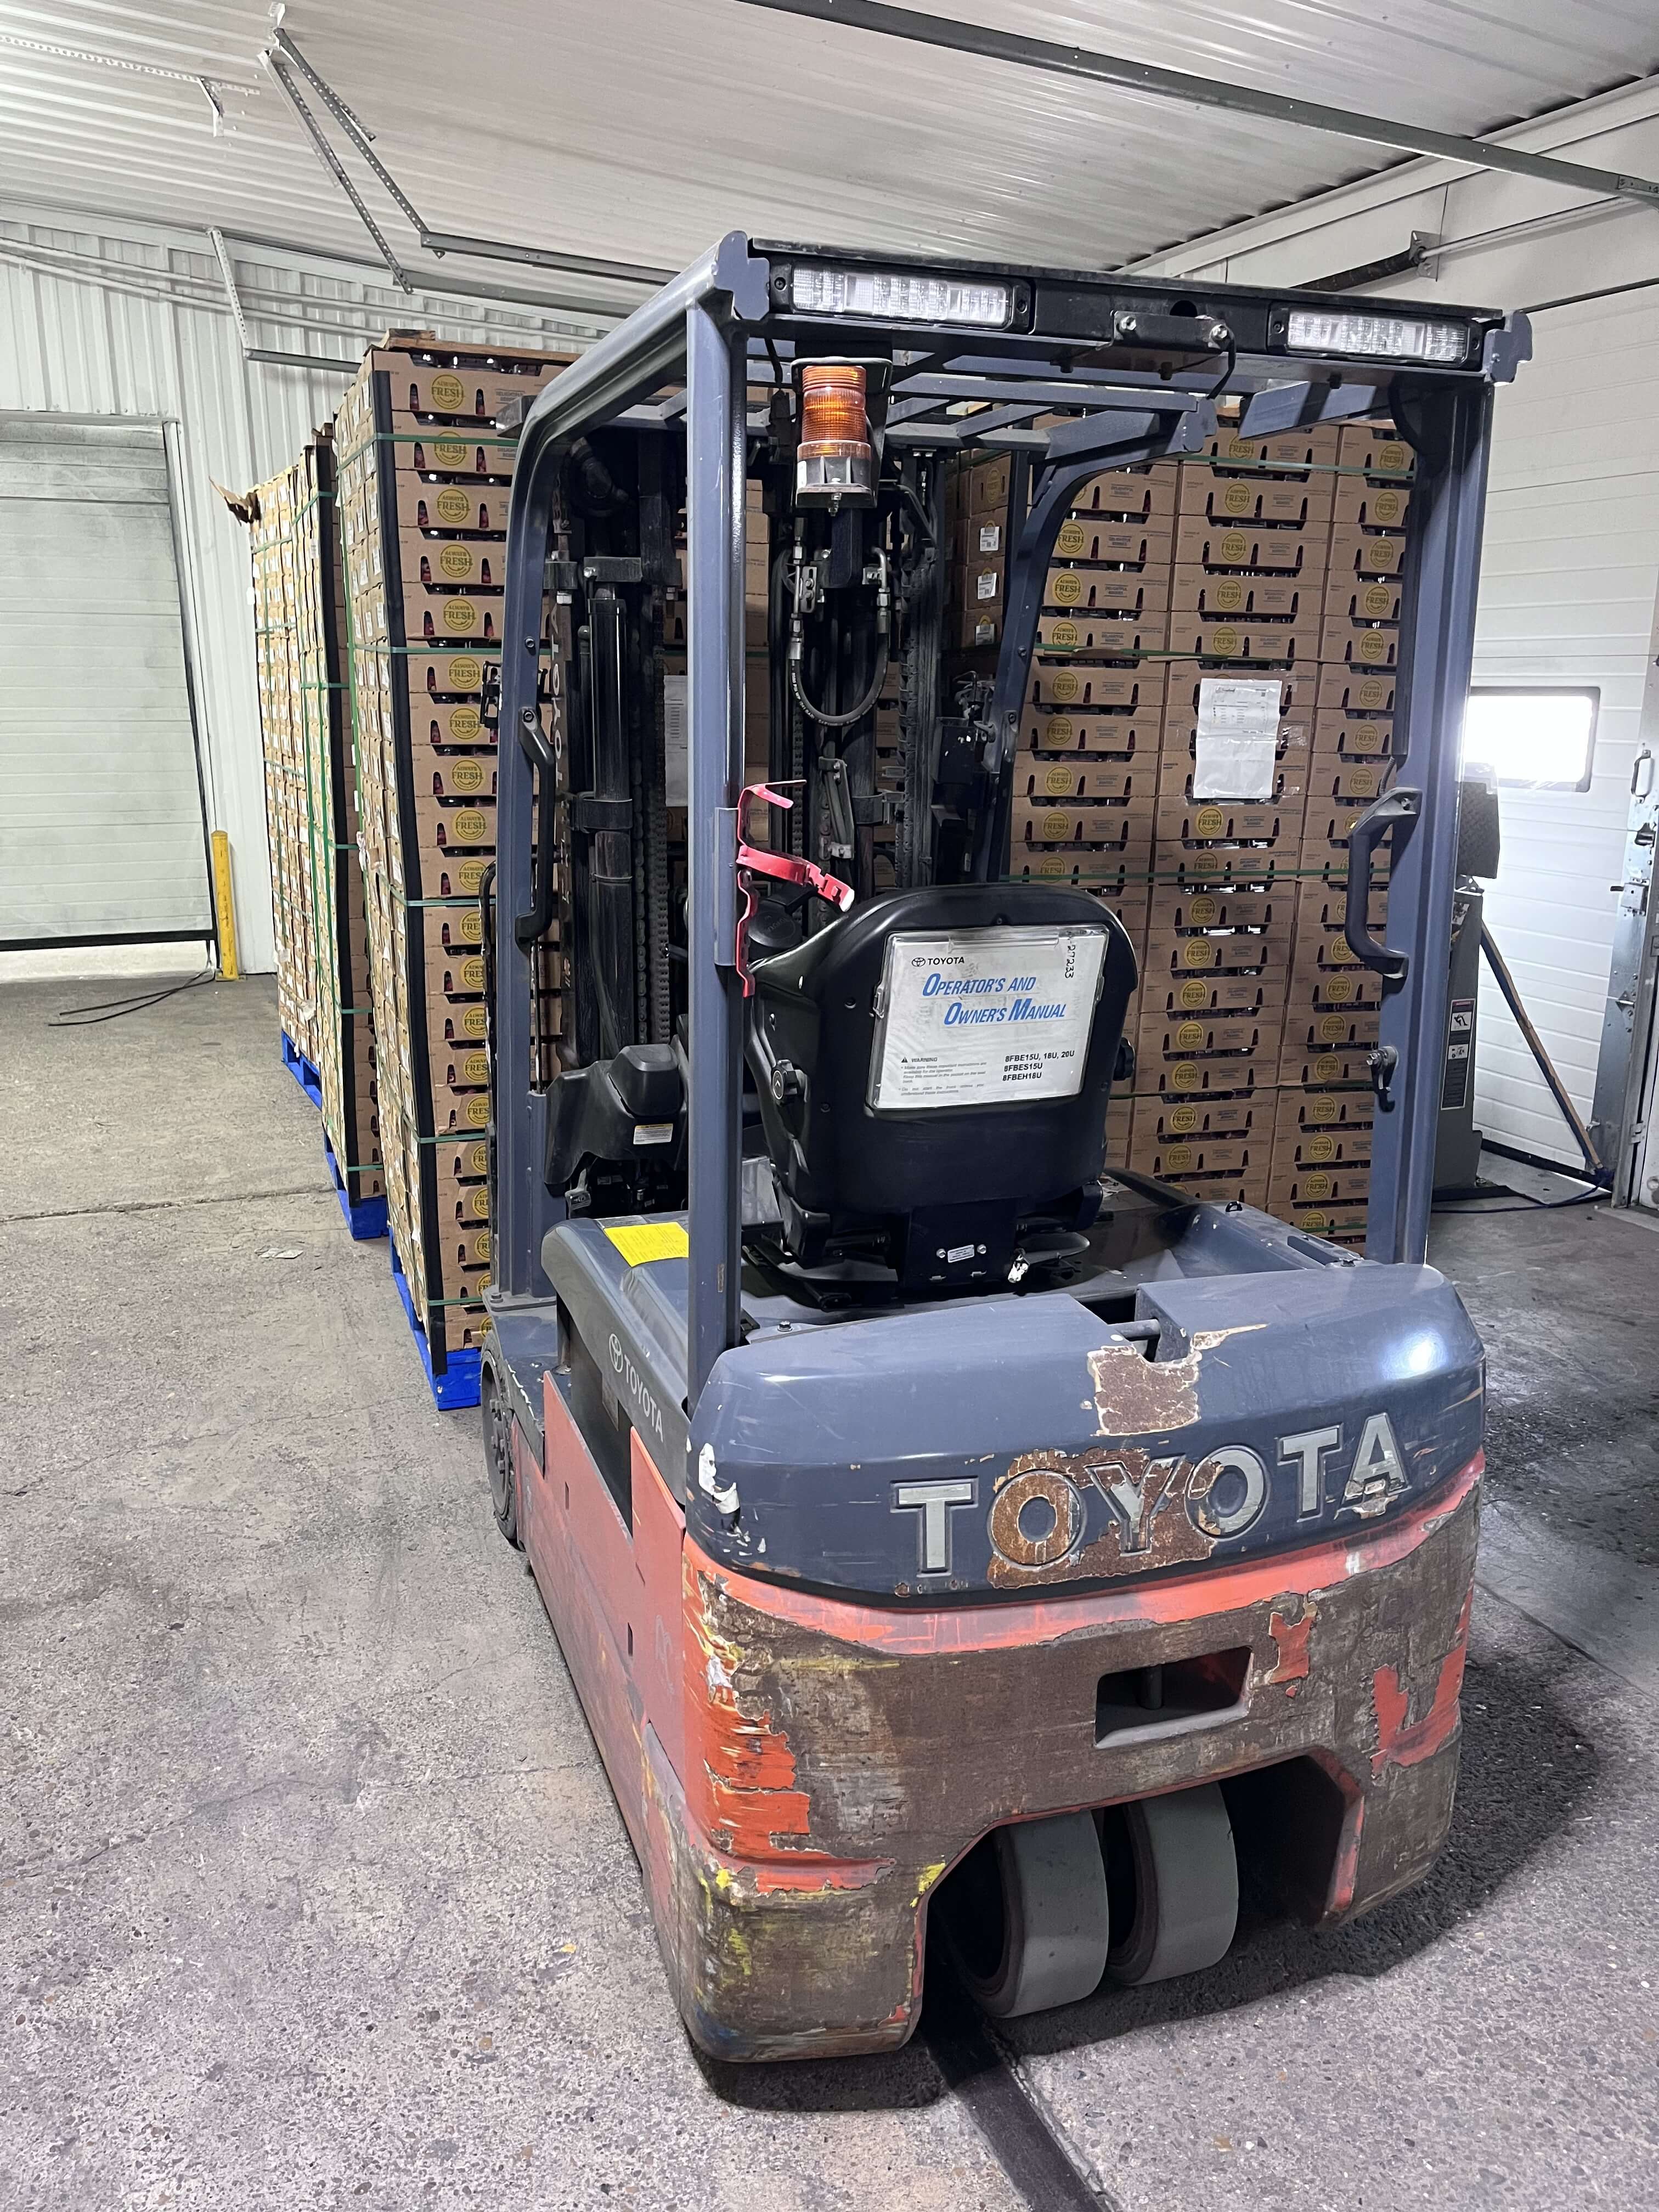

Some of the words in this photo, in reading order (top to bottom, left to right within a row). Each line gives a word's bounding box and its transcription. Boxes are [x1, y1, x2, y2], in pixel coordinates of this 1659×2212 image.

[431, 386, 465, 398] FRESH
[435, 443, 466, 454] FRESH
[437, 500, 470, 511] FRESH
[441, 556, 472, 567] FRESH
[444, 611, 476, 620] FRESH
[449, 669, 481, 678] FRESH
[449, 719, 481, 729] FRESH
[452, 771, 483, 780] FRESH
[455, 821, 487, 831] FRESH
[459, 871, 481, 879] FRES
[462, 923, 481, 931] FRE
[927, 956, 964, 966] TOYOTA
[922, 973, 1006, 996] OPERATOR'S
[1007, 977, 1036, 992] AND
[944, 1002, 1007, 1025] OWNER'S
[1008, 998, 1066, 1021] MANUAL
[465, 1018, 486, 1026] FRES
[1060, 1050, 1075, 1058] 20U
[465, 1063, 488, 1073] FRES
[1003, 1062, 1043, 1072] 8FBES15U
[1002, 1071, 1042, 1081] 8FBEH18U
[467, 1107, 490, 1116] FRES
[624, 1354, 663, 1443] TOYOTA
[891, 1412, 1409, 1577] TOYOTA
